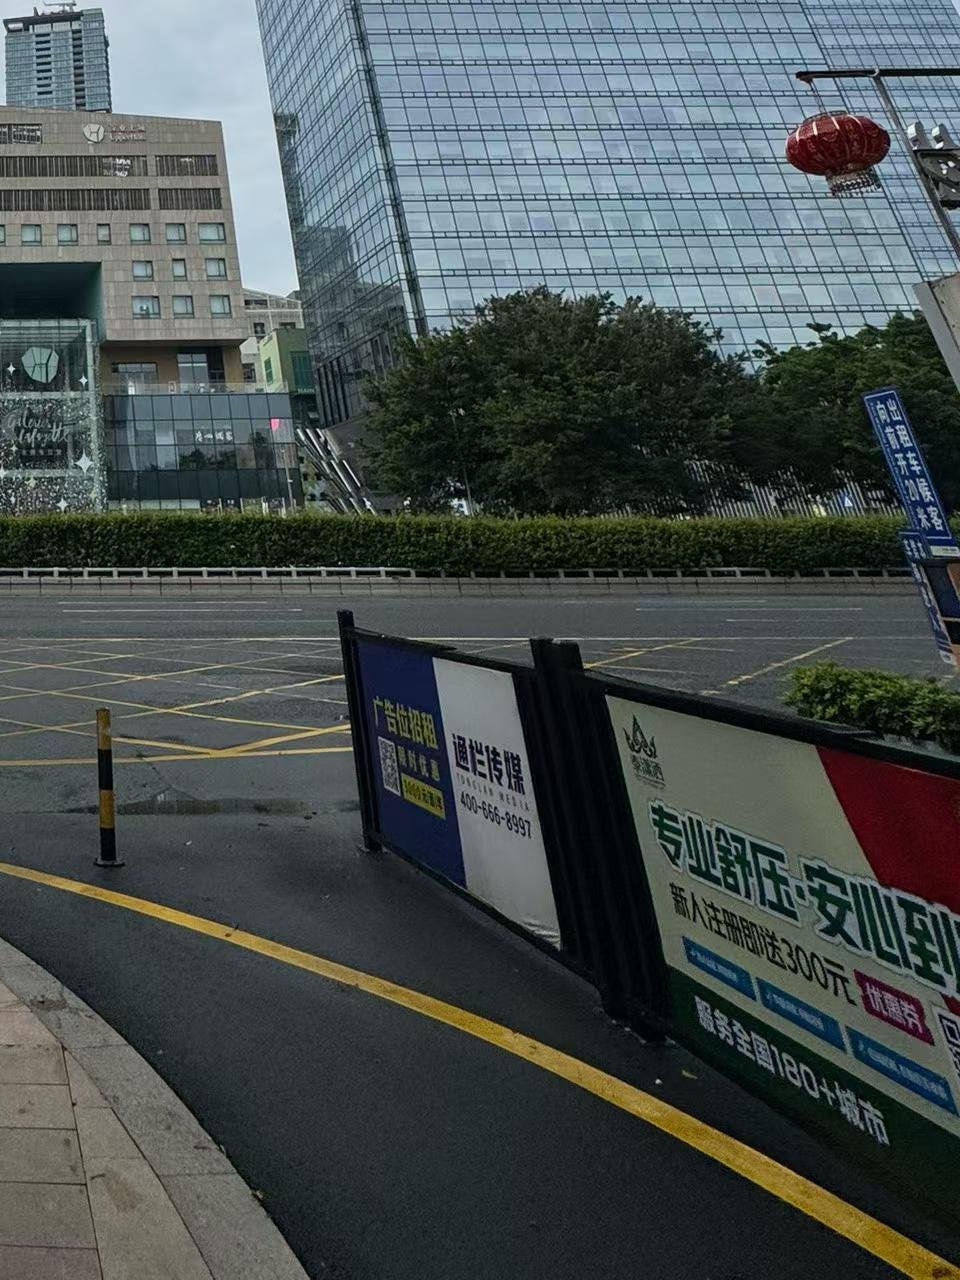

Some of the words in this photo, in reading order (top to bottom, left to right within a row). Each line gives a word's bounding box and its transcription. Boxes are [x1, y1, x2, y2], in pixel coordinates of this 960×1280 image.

[887, 399, 944, 532] 出租车候客
[372, 695, 439, 750] 广告位招租
[452, 732, 526, 796] 通栏传媒
[460, 790, 532, 840] 400-666-8997
[650, 802, 960, 990] 专业舒压·安心到
[668, 881, 858, 1007] 新人注册即送300元
[865, 981, 924, 1035] 优惠券
[693, 995, 891, 1146] 服务全国180+城市
